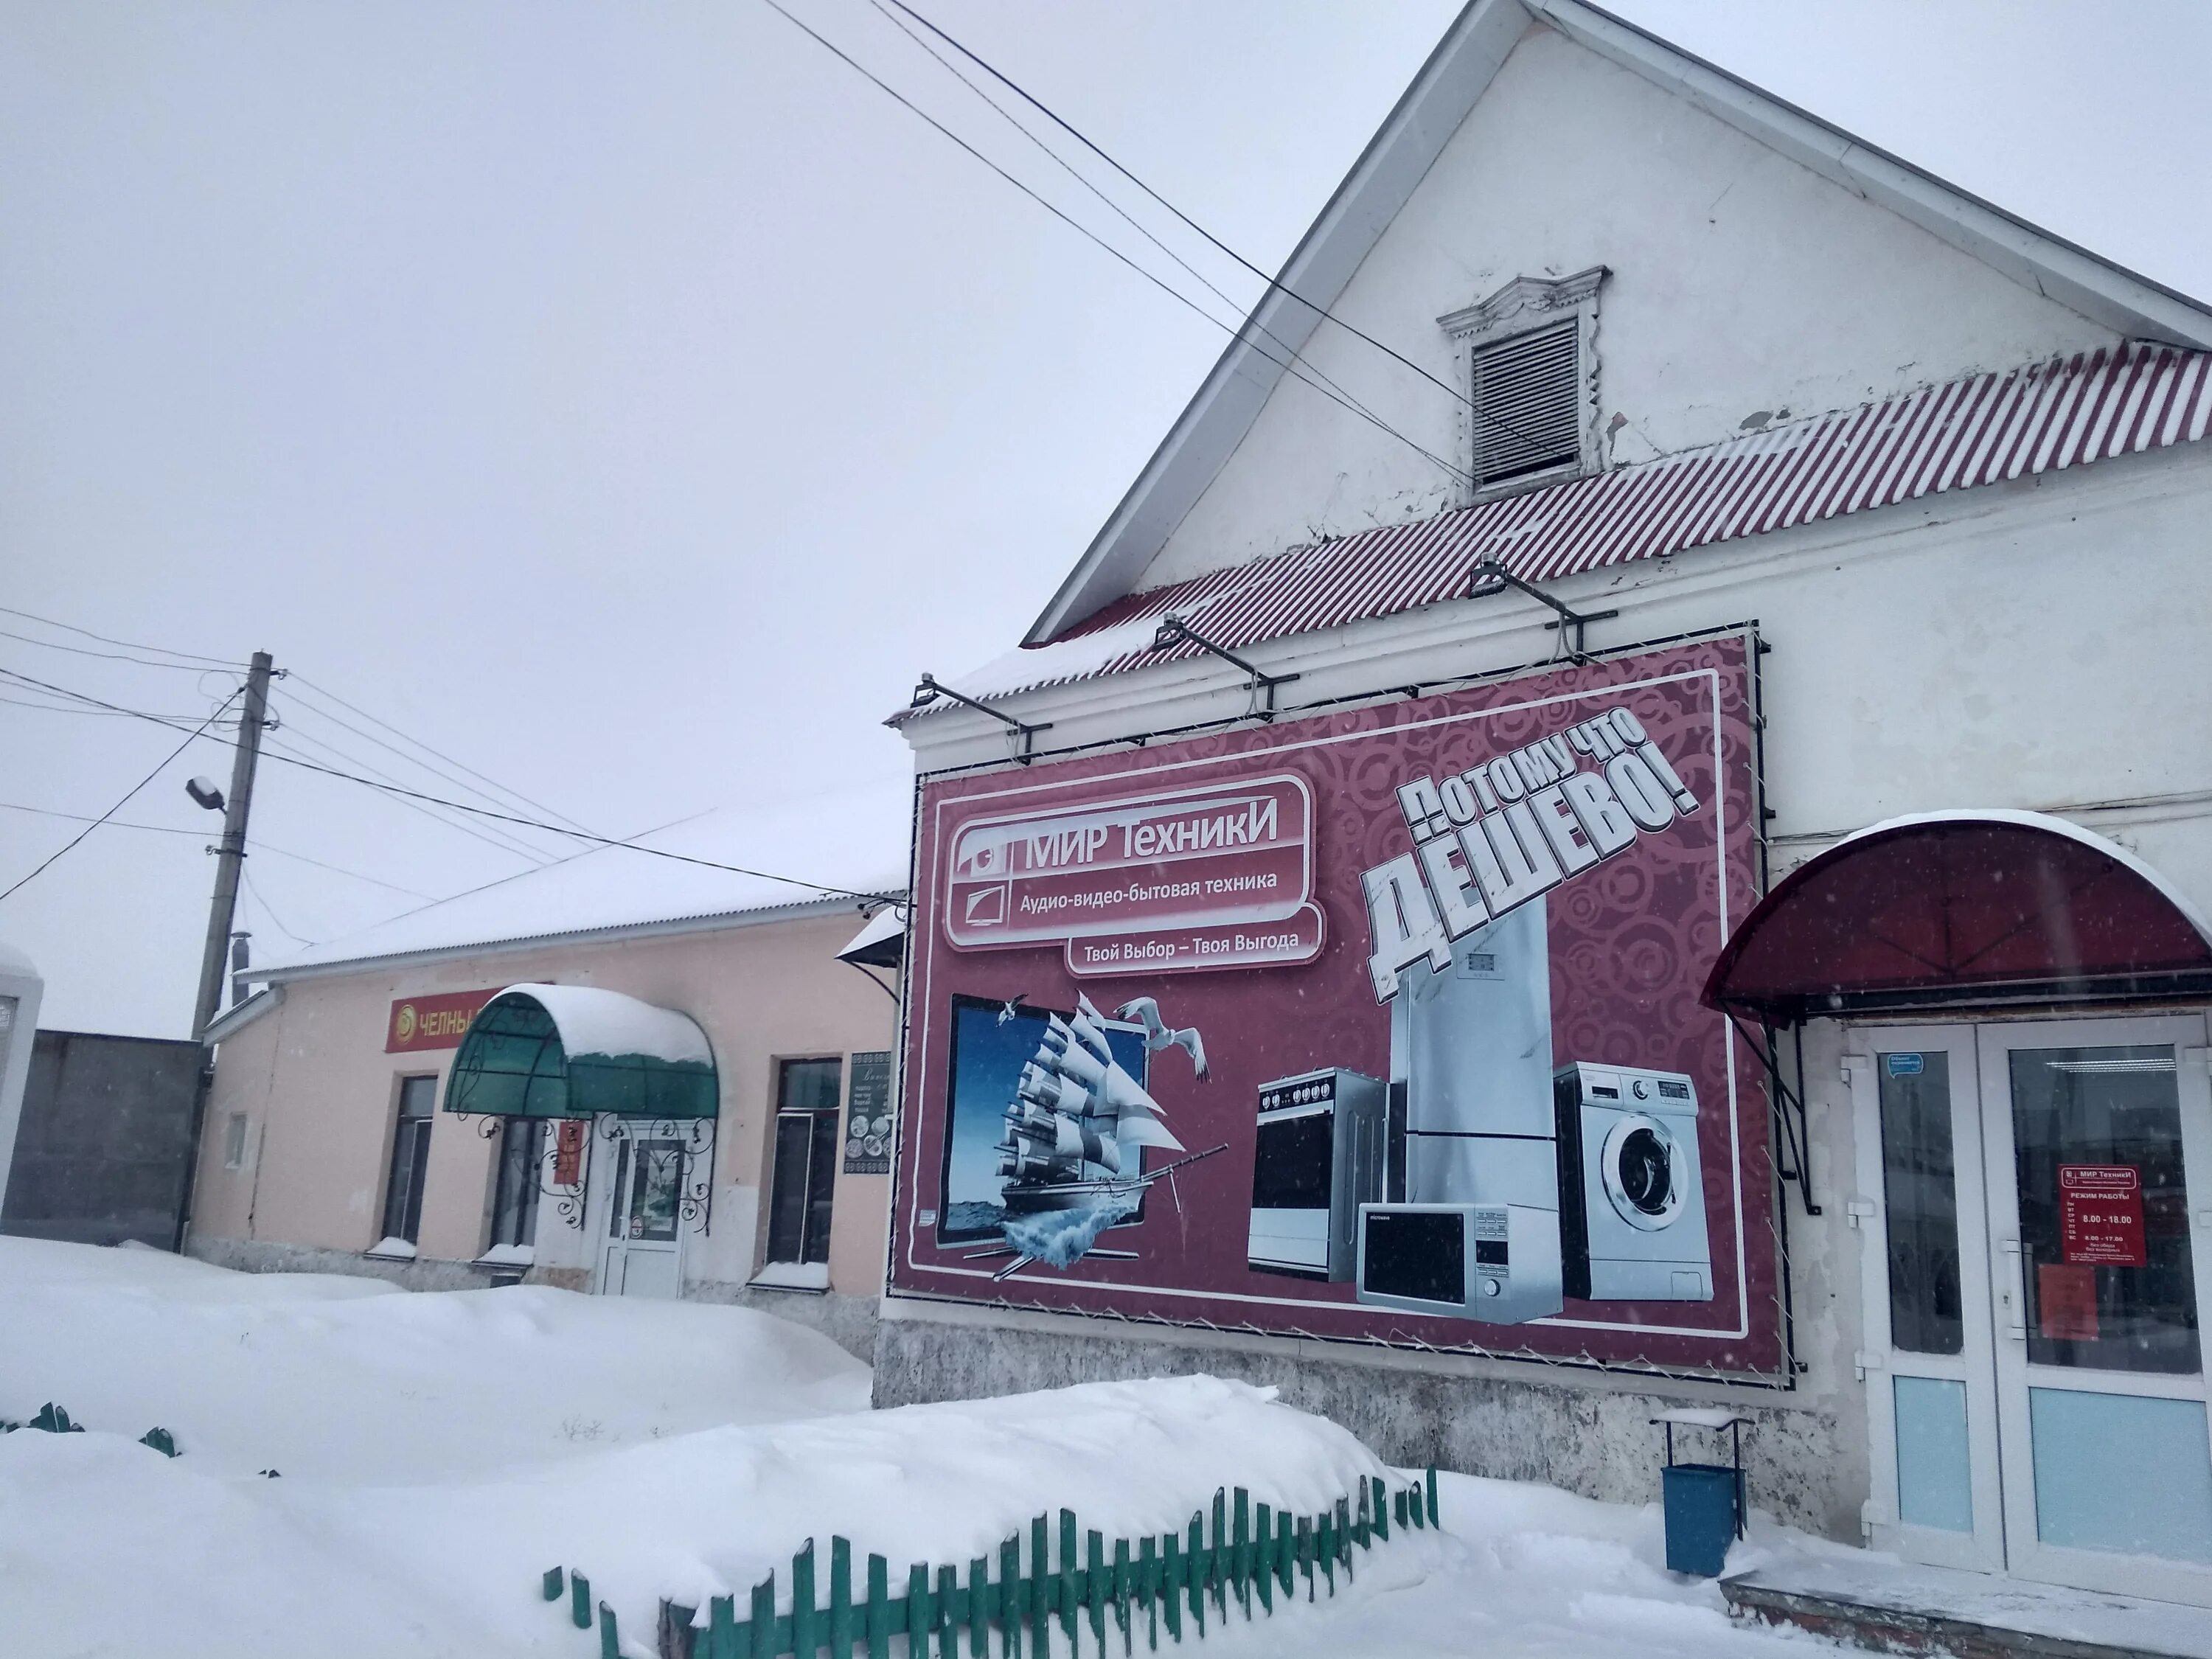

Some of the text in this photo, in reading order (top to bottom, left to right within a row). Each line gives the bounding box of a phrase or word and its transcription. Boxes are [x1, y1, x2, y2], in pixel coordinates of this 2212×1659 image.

[1395, 706, 1647, 846] ПОТОМУ ЧТО
[1025, 824, 1109, 870] МИР
[1020, 873, 1278, 914] Аудио-видео-бытовая техника
[1360, 740, 1700, 1006] ДЕШЕВО!
[1085, 942, 1120, 964] Твой
[1123, 939, 1176, 961] Выбор
[1193, 936, 1230, 956] Твоя
[1234, 932, 1299, 952] Выгода
[420, 1009, 477, 1037] ЧЕЛНЫ
[2083, 1215, 2101, 1223] 8.00
[2109, 1216, 2132, 1224] 18.00
